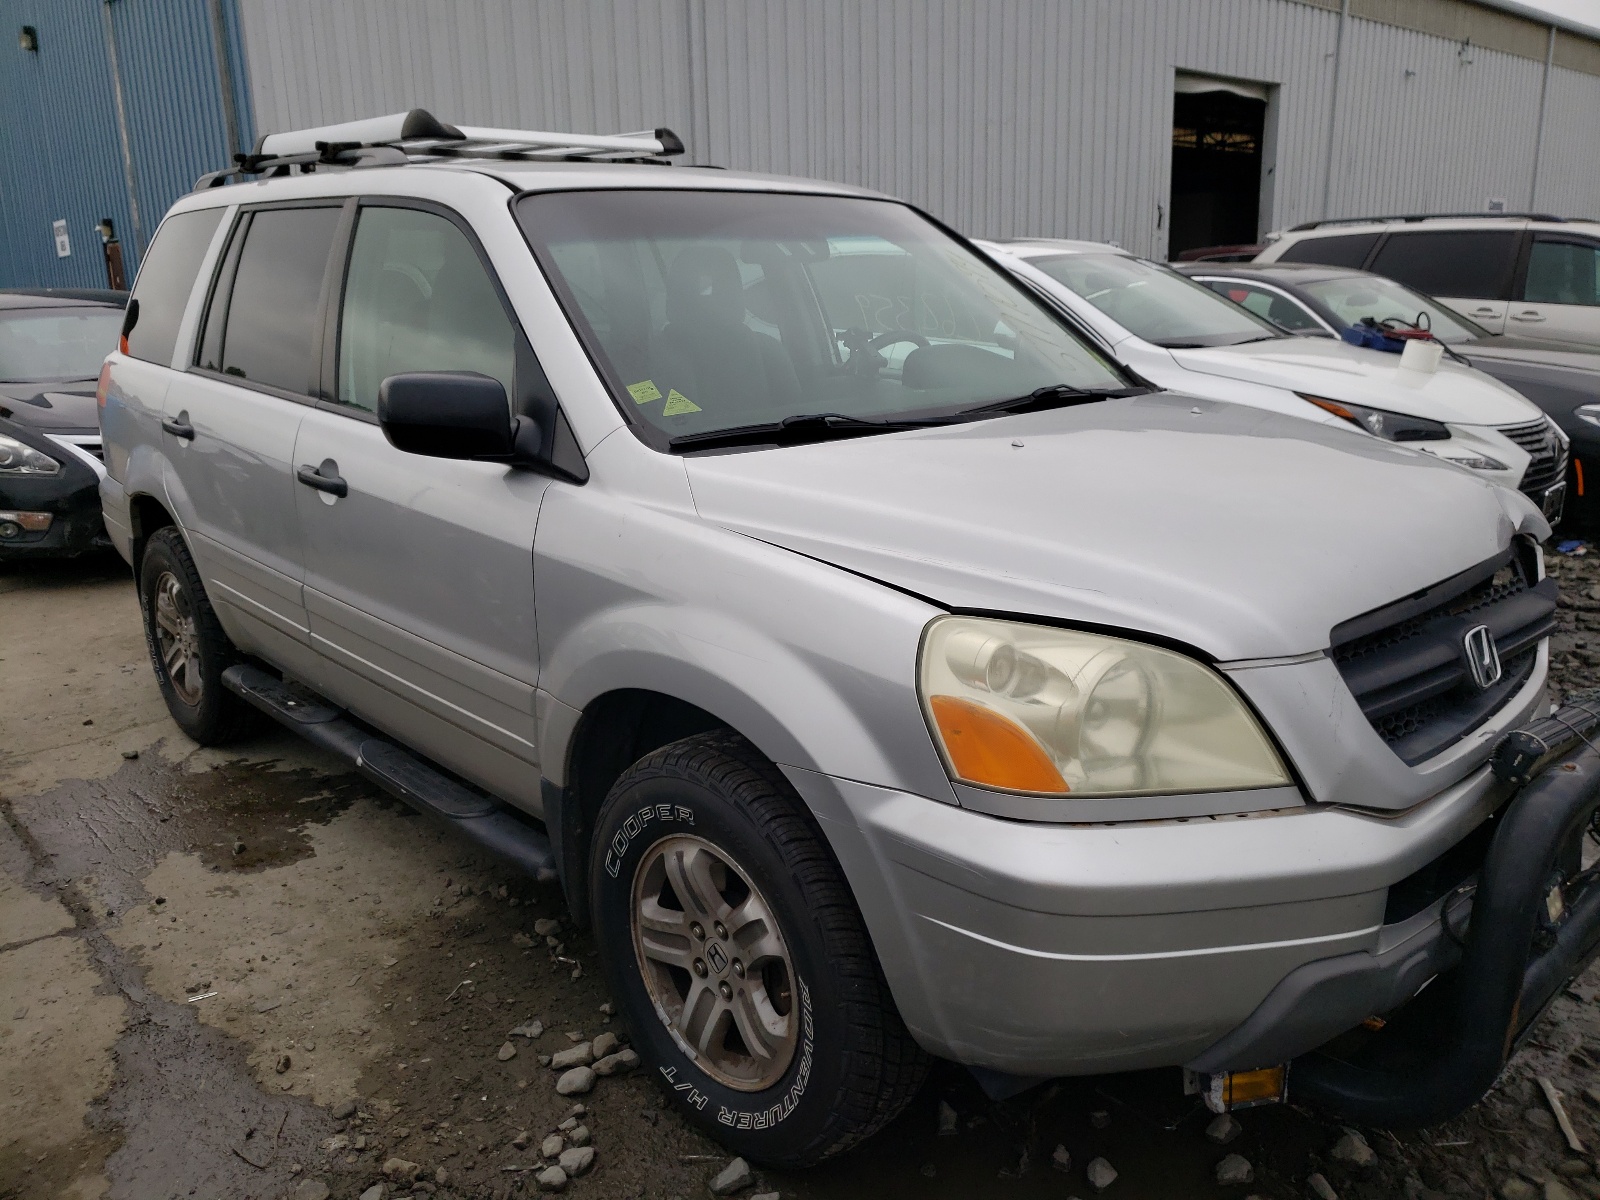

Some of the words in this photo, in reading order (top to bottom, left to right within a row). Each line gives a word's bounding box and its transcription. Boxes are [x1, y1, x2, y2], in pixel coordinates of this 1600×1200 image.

[605, 804, 695, 878] COOPER
[660, 1065, 708, 1110] H/T
[718, 976, 814, 1130] ADVENTURER
